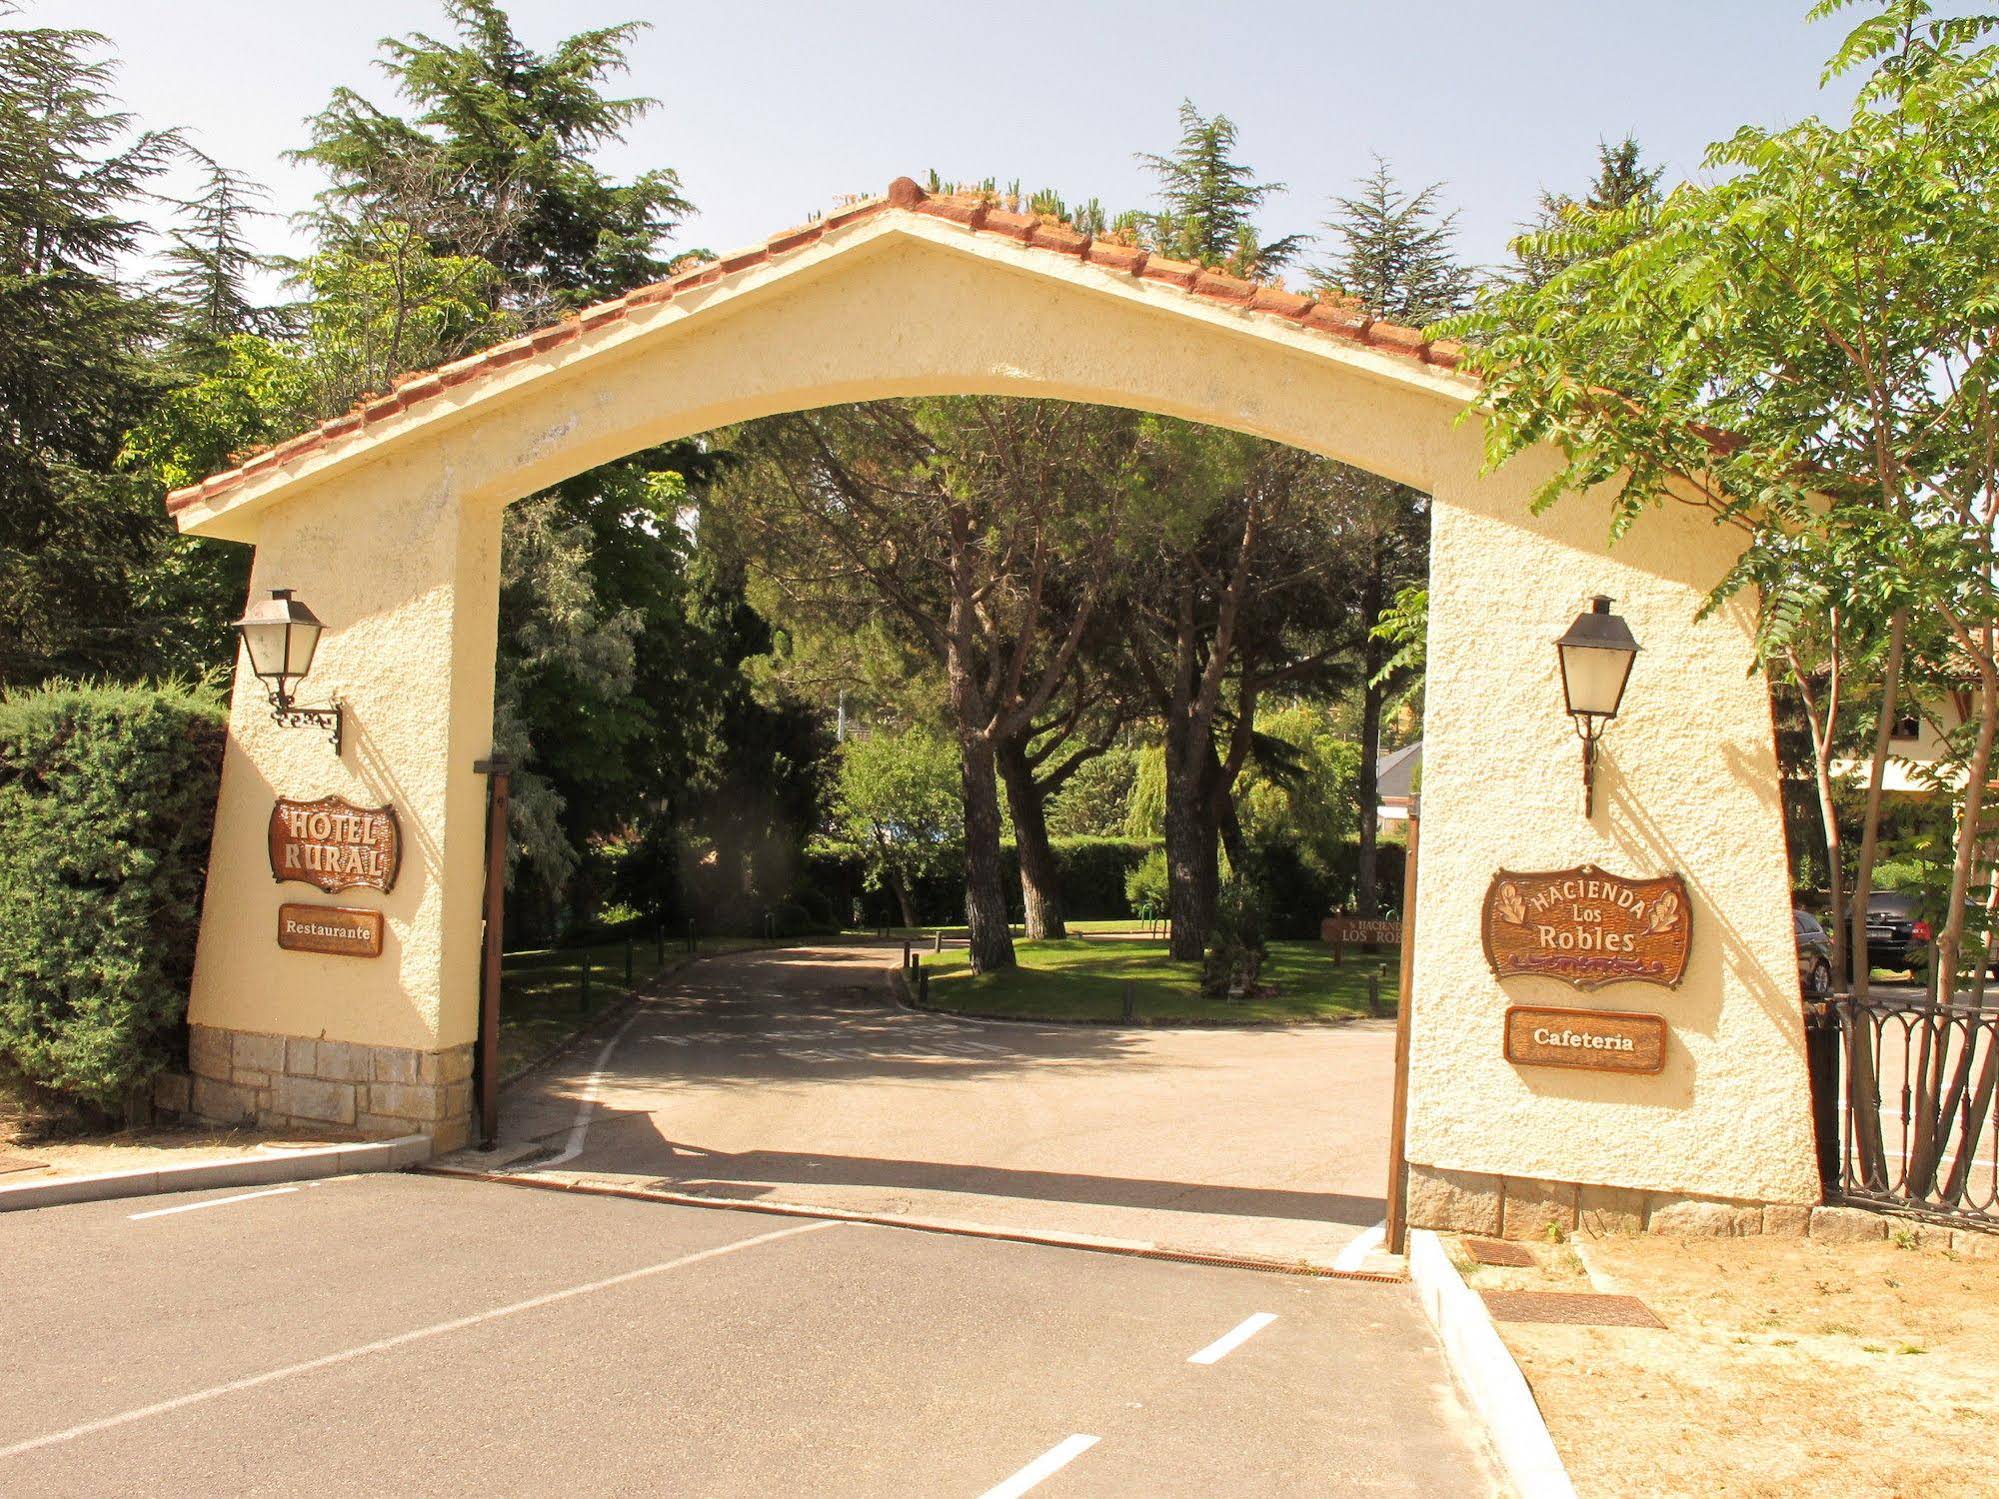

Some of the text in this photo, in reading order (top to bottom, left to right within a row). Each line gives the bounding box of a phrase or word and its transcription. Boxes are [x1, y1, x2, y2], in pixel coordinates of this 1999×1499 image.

[289, 810, 377, 844] HOTEL
[285, 843, 383, 876] RURAL
[1530, 879, 1646, 920] HACIENDA
[1573, 904, 1602, 923] Los
[286, 920, 372, 940] Restaurante
[1342, 929, 1367, 942] LOS
[1537, 925, 1636, 952] Robles
[1533, 1028, 1635, 1052] Cafeteria
